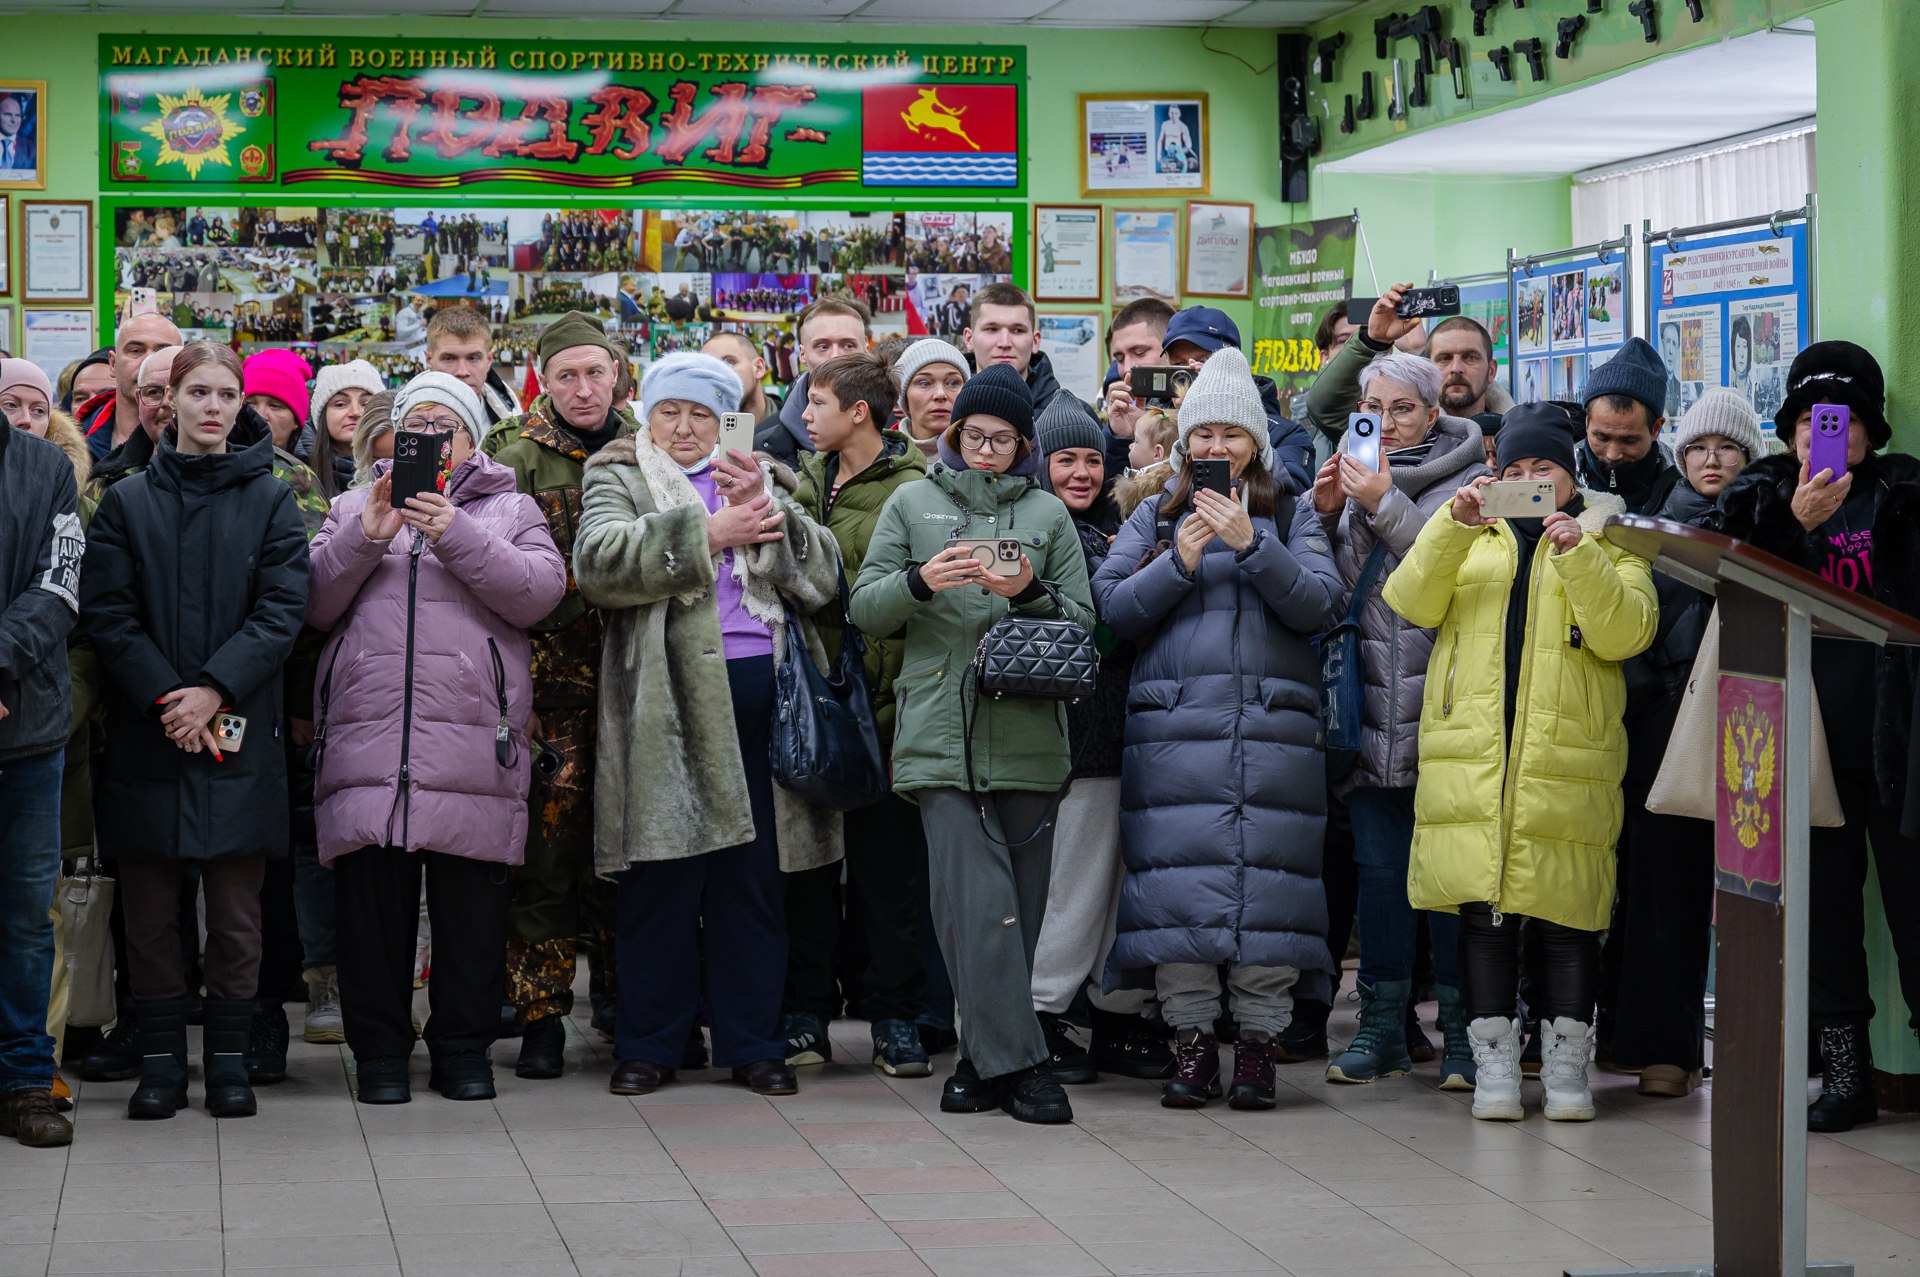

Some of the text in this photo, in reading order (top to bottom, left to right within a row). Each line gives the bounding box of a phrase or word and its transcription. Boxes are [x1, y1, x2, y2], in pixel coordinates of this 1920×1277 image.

[112, 43, 1016, 76] МАГАДАНСКИЙ ВОЕННЫЙ СПОРТИВНО-ТЕХНИЧЕСКИЙ ЦЕНТР
[1197, 235, 1239, 247] ДИПЛОМ
[1289, 249, 1318, 266] МБУДО
[1768, 257, 1789, 270] ВОЙНЫ
[1262, 268, 1345, 288] Магаданский военный
[1260, 287, 1346, 309] спортивно-технический
[1290, 312, 1313, 327] центр
